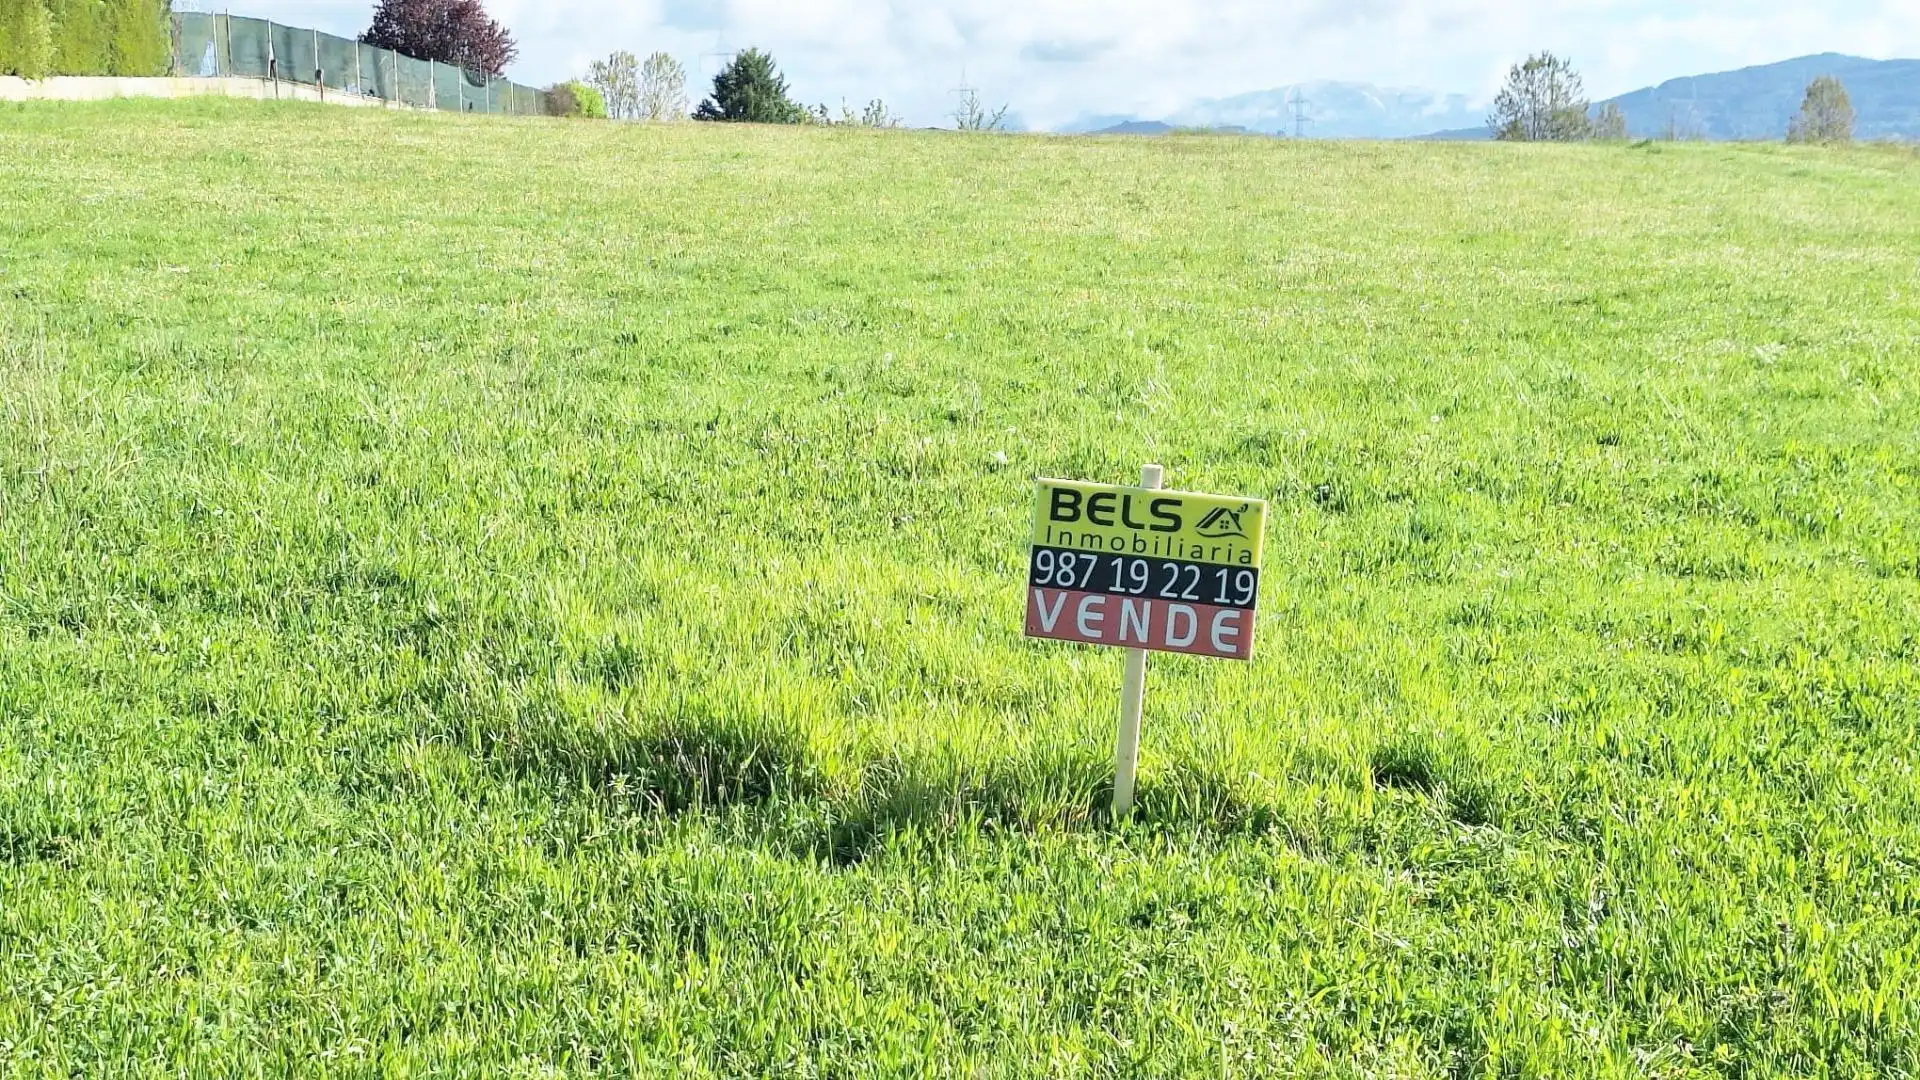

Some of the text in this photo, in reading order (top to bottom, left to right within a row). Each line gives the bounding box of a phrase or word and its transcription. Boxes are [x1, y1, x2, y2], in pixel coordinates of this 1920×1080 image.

[1050, 488, 1183, 533] BELS
[1046, 525, 1251, 564] Inmobiliaria
[1035, 550, 1255, 605] 987 19 22 19
[1035, 589, 1240, 653] VENDE
